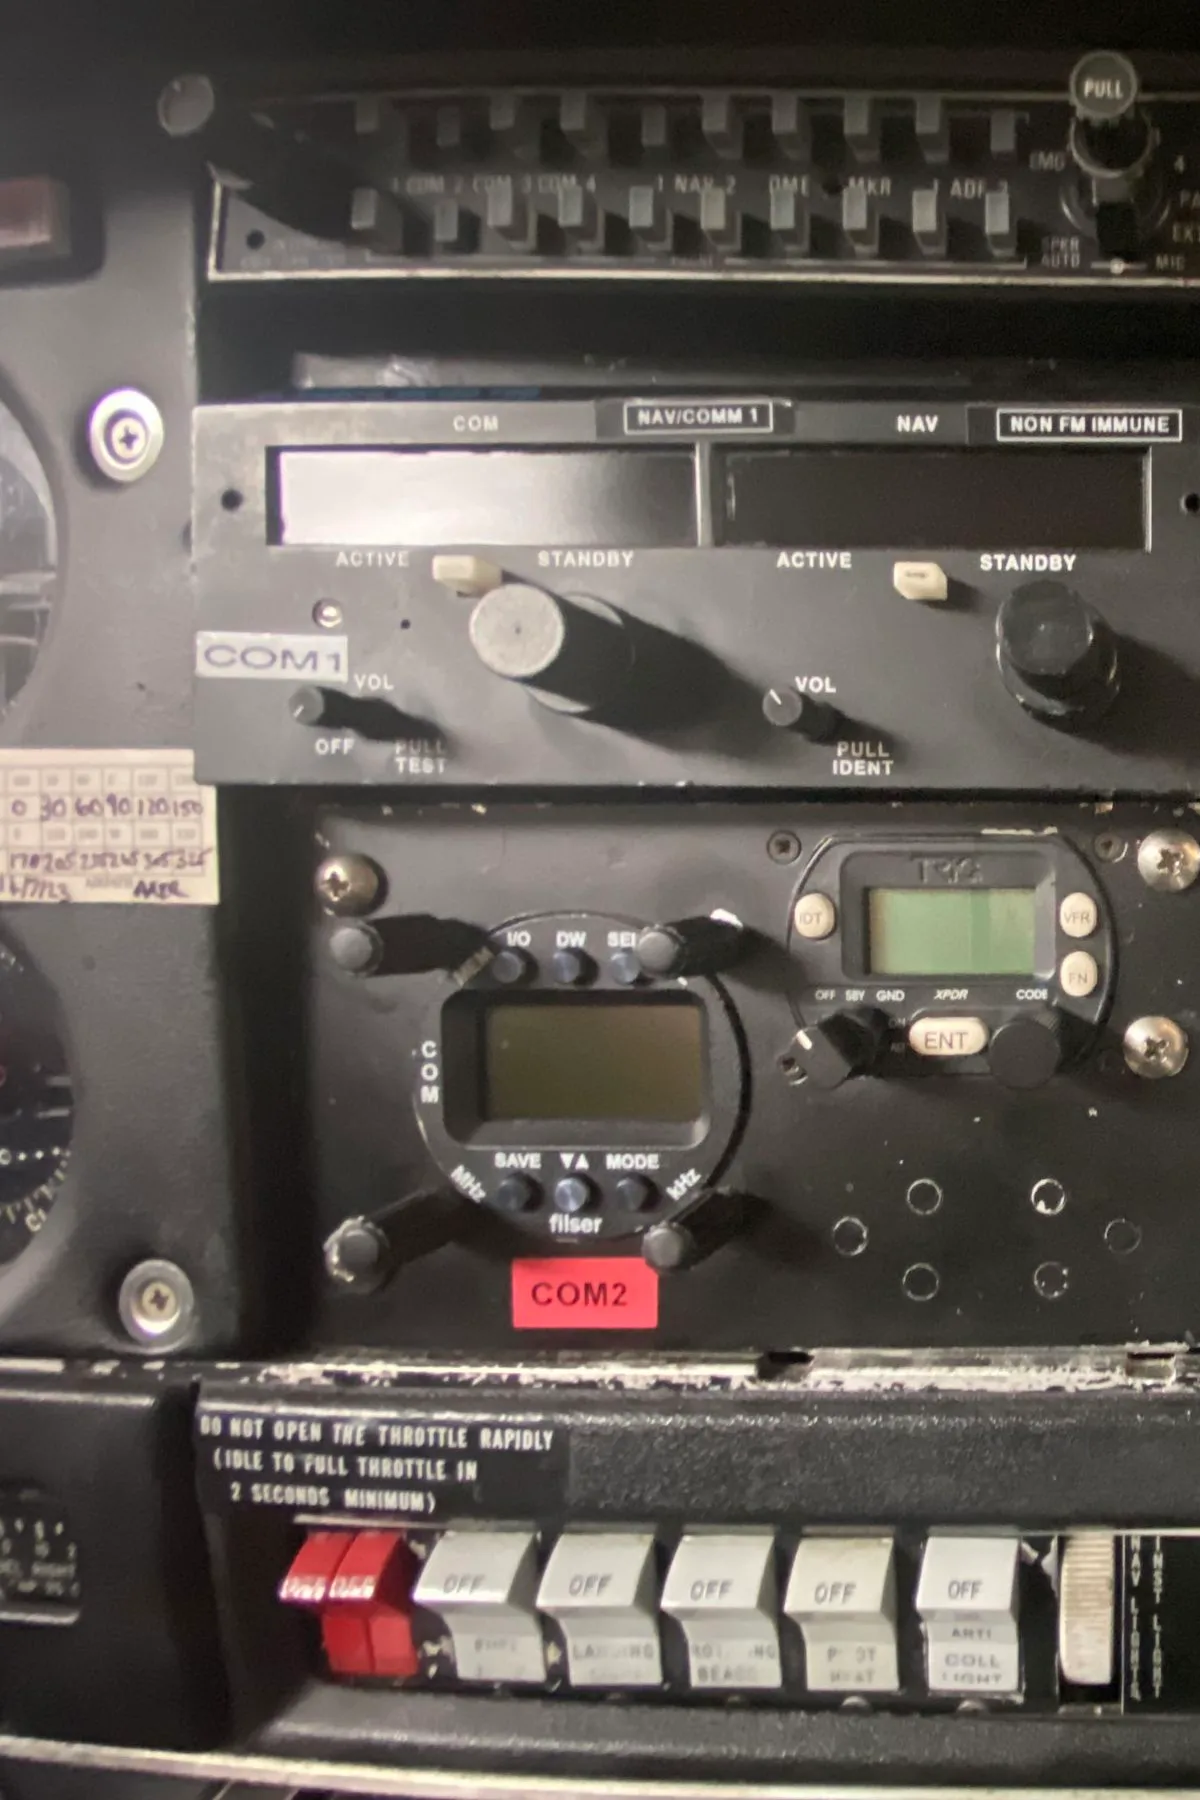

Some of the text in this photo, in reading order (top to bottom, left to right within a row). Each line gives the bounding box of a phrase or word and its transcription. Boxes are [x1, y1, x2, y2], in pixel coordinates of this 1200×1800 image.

[1083, 78, 1124, 100] PULL
[725, 176, 737, 193] 2
[453, 415, 499, 432] COM
[637, 407, 759, 425] NAV/COMM 1
[896, 415, 939, 433] NAV
[1010, 416, 1171, 434] NON FM IMMUNE
[335, 550, 410, 568] ACTIVE
[537, 550, 634, 568] STANDBY
[776, 551, 852, 569] ACTIVE
[979, 553, 1077, 572] STANDBY
[204, 644, 342, 672] COM1
[354, 673, 394, 690] VOL
[795, 676, 837, 693] VOL
[315, 738, 355, 755] OFF
[837, 741, 890, 758] PULL
[395, 757, 447, 773] TEST
[832, 759, 894, 775] IDENT
[12, 792, 203, 821] 0 30 60 90 120 150
[1063, 911, 1091, 925] VFR
[507, 930, 532, 948] I/O
[556, 930, 587, 948] DW
[1068, 971, 1088, 985] FN
[815, 989, 836, 1001] OFF
[876, 989, 906, 1002] GND
[934, 989, 969, 1000] XPDR
[1016, 988, 1048, 1000] CODE
[924, 1031, 968, 1049] ENT
[420, 1040, 440, 1104] COM
[494, 1152, 542, 1170] SAVE
[606, 1153, 660, 1170] MODE
[450, 1163, 487, 1204] MHz
[665, 1168, 703, 1201] kHz
[548, 1212, 604, 1234] filser
[530, 1282, 629, 1307] COM2
[200, 1415, 554, 1452] DO NOT OPEN THE THROTTLE RAPIDLY
[213, 1447, 478, 1481] (IDLE TO FULL THROTTLE IN
[230, 1482, 436, 1514] 2 SECONDS MINIMUM)
[443, 1574, 486, 1594] OFF
[568, 1574, 613, 1596] OFF
[689, 1580, 733, 1601] OFF
[814, 1582, 857, 1604] OFF
[947, 1580, 982, 1601] OFF
[944, 1653, 1000, 1668] COLL
